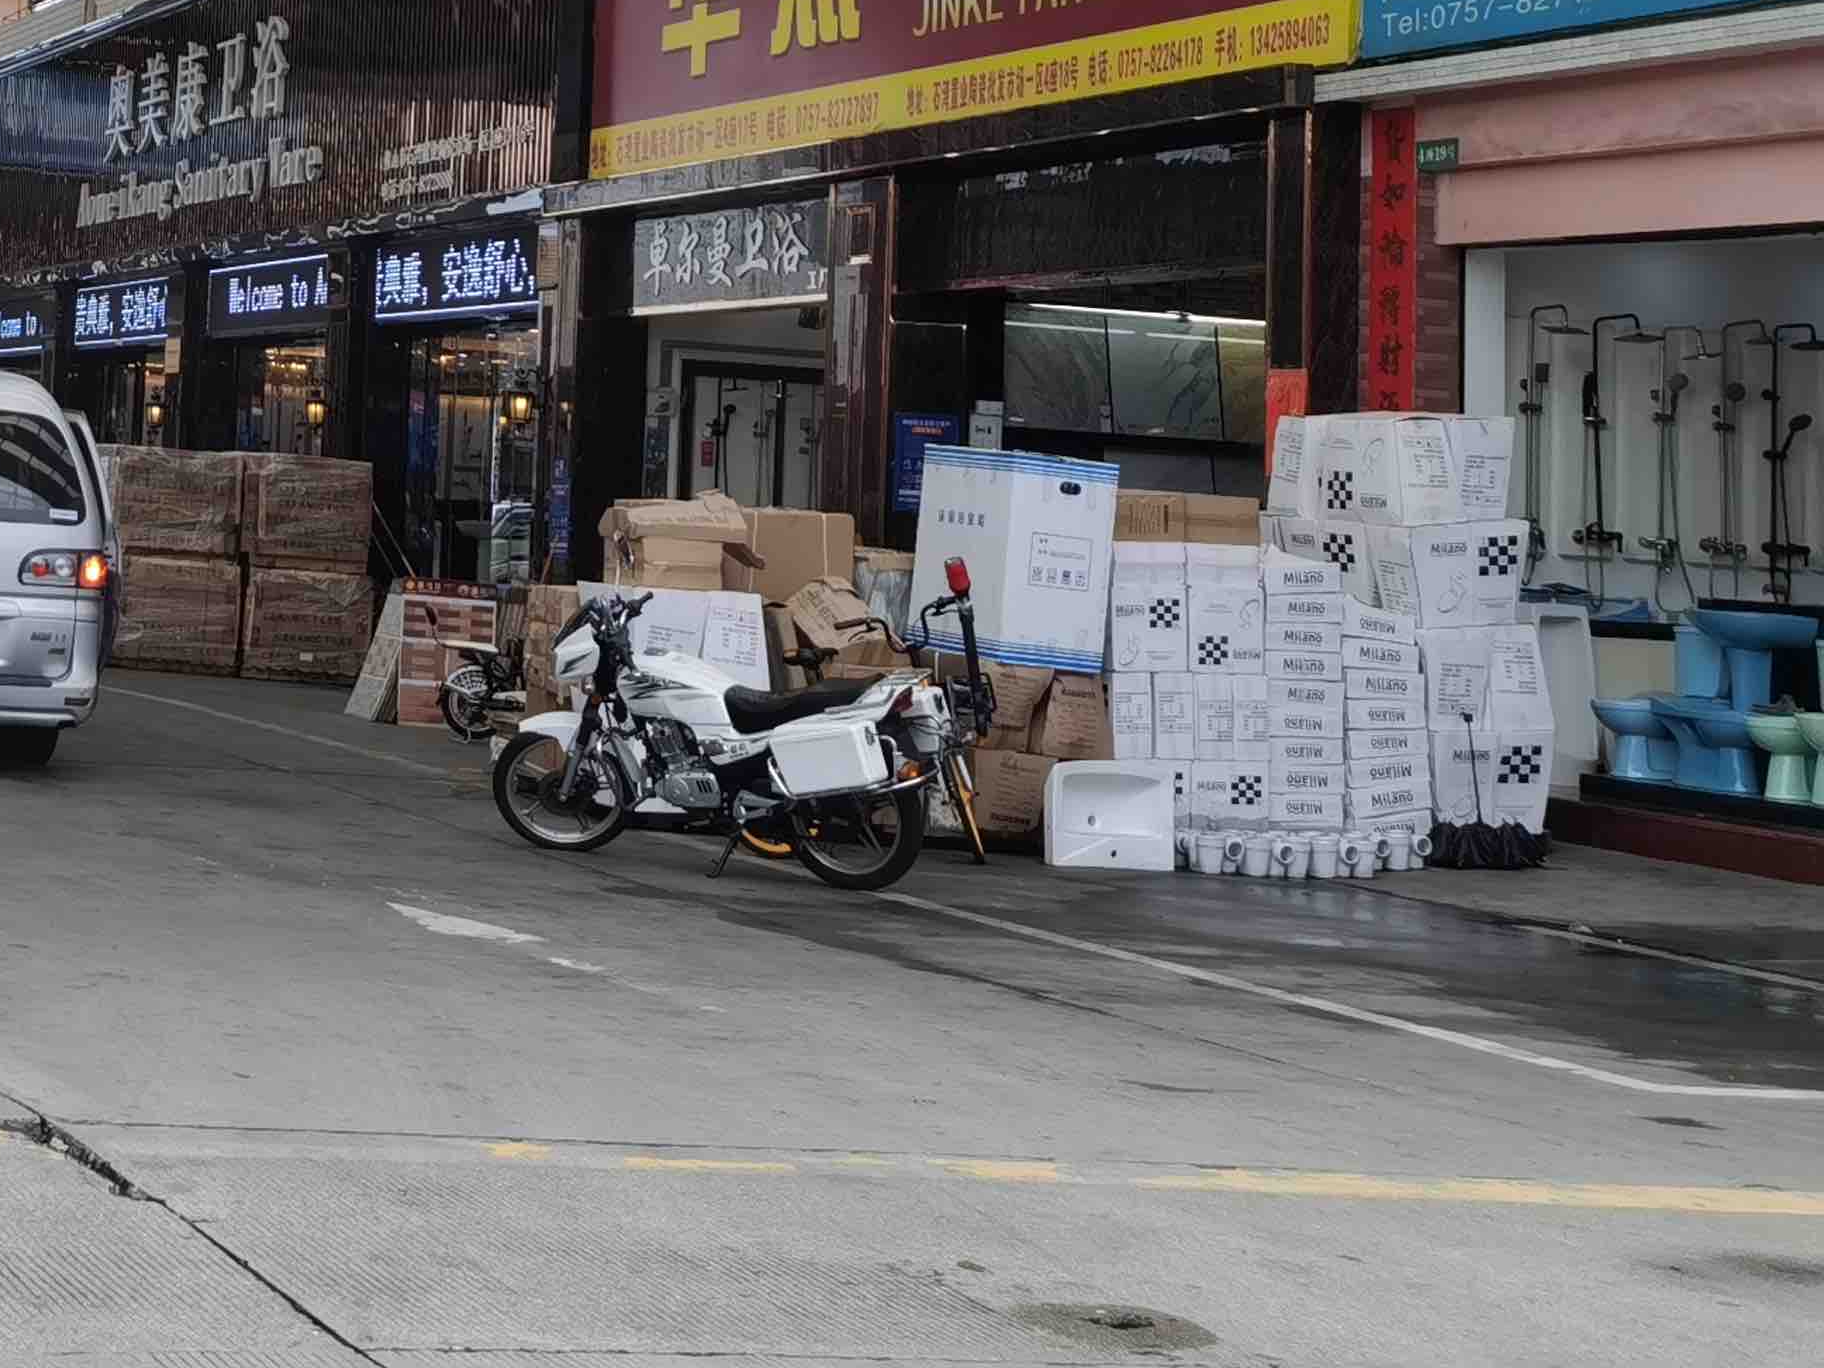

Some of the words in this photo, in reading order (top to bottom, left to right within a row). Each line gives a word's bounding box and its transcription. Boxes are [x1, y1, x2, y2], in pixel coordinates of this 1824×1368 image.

[103, 15, 292, 164] 奥美康卫浴
[643, 210, 810, 297] 卓尔曼卫浴
[228, 275, 283, 315] Welcome
[290, 273, 307, 309] to
[1283, 570, 1325, 586] Milano
[1287, 601, 1326, 615] Milano
[1283, 629, 1324, 644] Milano
[1359, 646, 1402, 663] Milano
[1282, 657, 1326, 674] Milano
[1365, 677, 1409, 693] Milano
[1287, 687, 1326, 702] Milano
[1370, 790, 1415, 807] Milano
